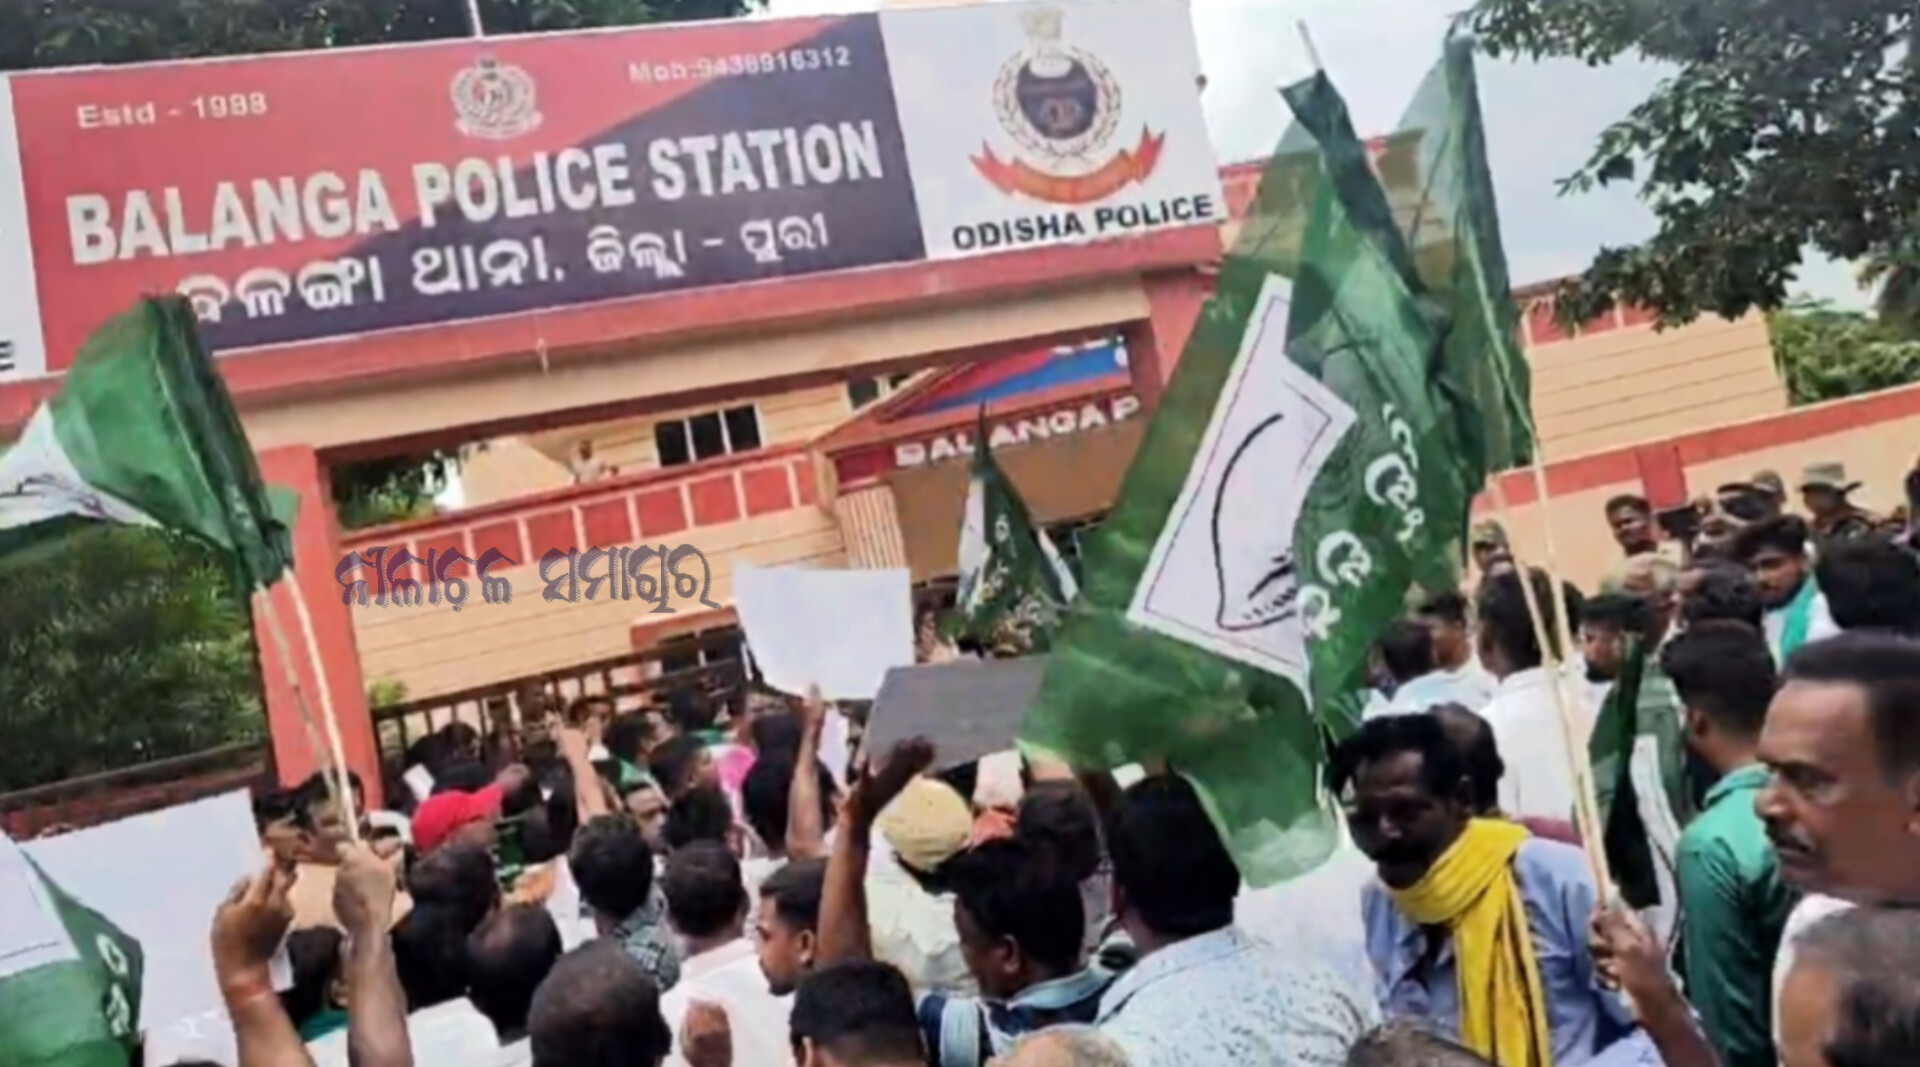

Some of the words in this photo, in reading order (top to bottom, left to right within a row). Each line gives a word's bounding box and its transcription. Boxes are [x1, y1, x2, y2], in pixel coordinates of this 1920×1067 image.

[77, 102, 155, 129] Estd
[192, 91, 267, 119] 1988
[66, 167, 399, 265] BALANGA
[412, 142, 636, 228] POLICE
[648, 119, 884, 201] STATION
[952, 211, 1085, 250] ODISHA
[1095, 194, 1214, 231] POLICE
[895, 405, 1107, 467] BALANGA
